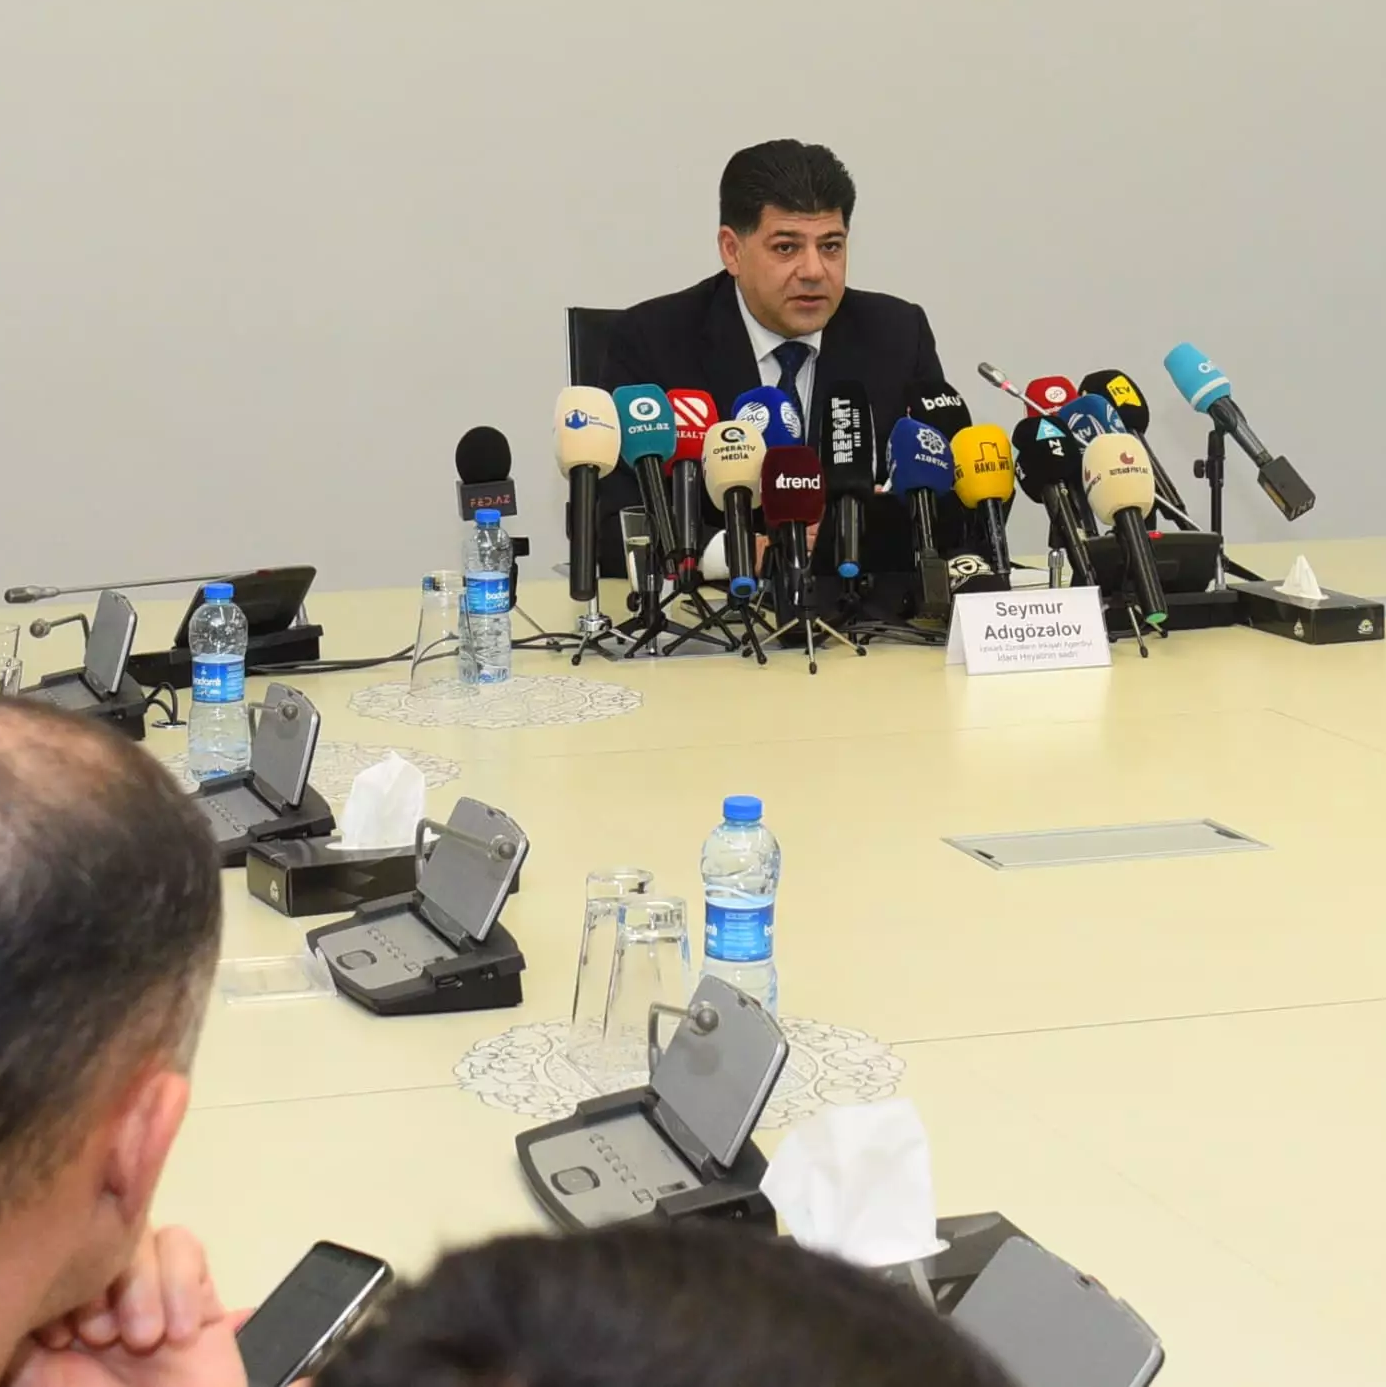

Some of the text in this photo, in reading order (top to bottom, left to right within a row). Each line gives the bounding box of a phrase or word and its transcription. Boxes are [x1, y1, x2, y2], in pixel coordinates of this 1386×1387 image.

[921, 393, 962, 411] baku
[628, 422, 670, 434] oxu.az
[676, 430, 705, 441] EALT
[831, 397, 853, 465] REPORT
[713, 444, 756, 455] OPERATİV
[721, 453, 749, 462] MEDİA
[776, 472, 821, 489] trend
[470, 494, 511, 508] FED.AZ
[996, 601, 1063, 620] Seymur
[984, 622, 1082, 642] Adıgözəlov
